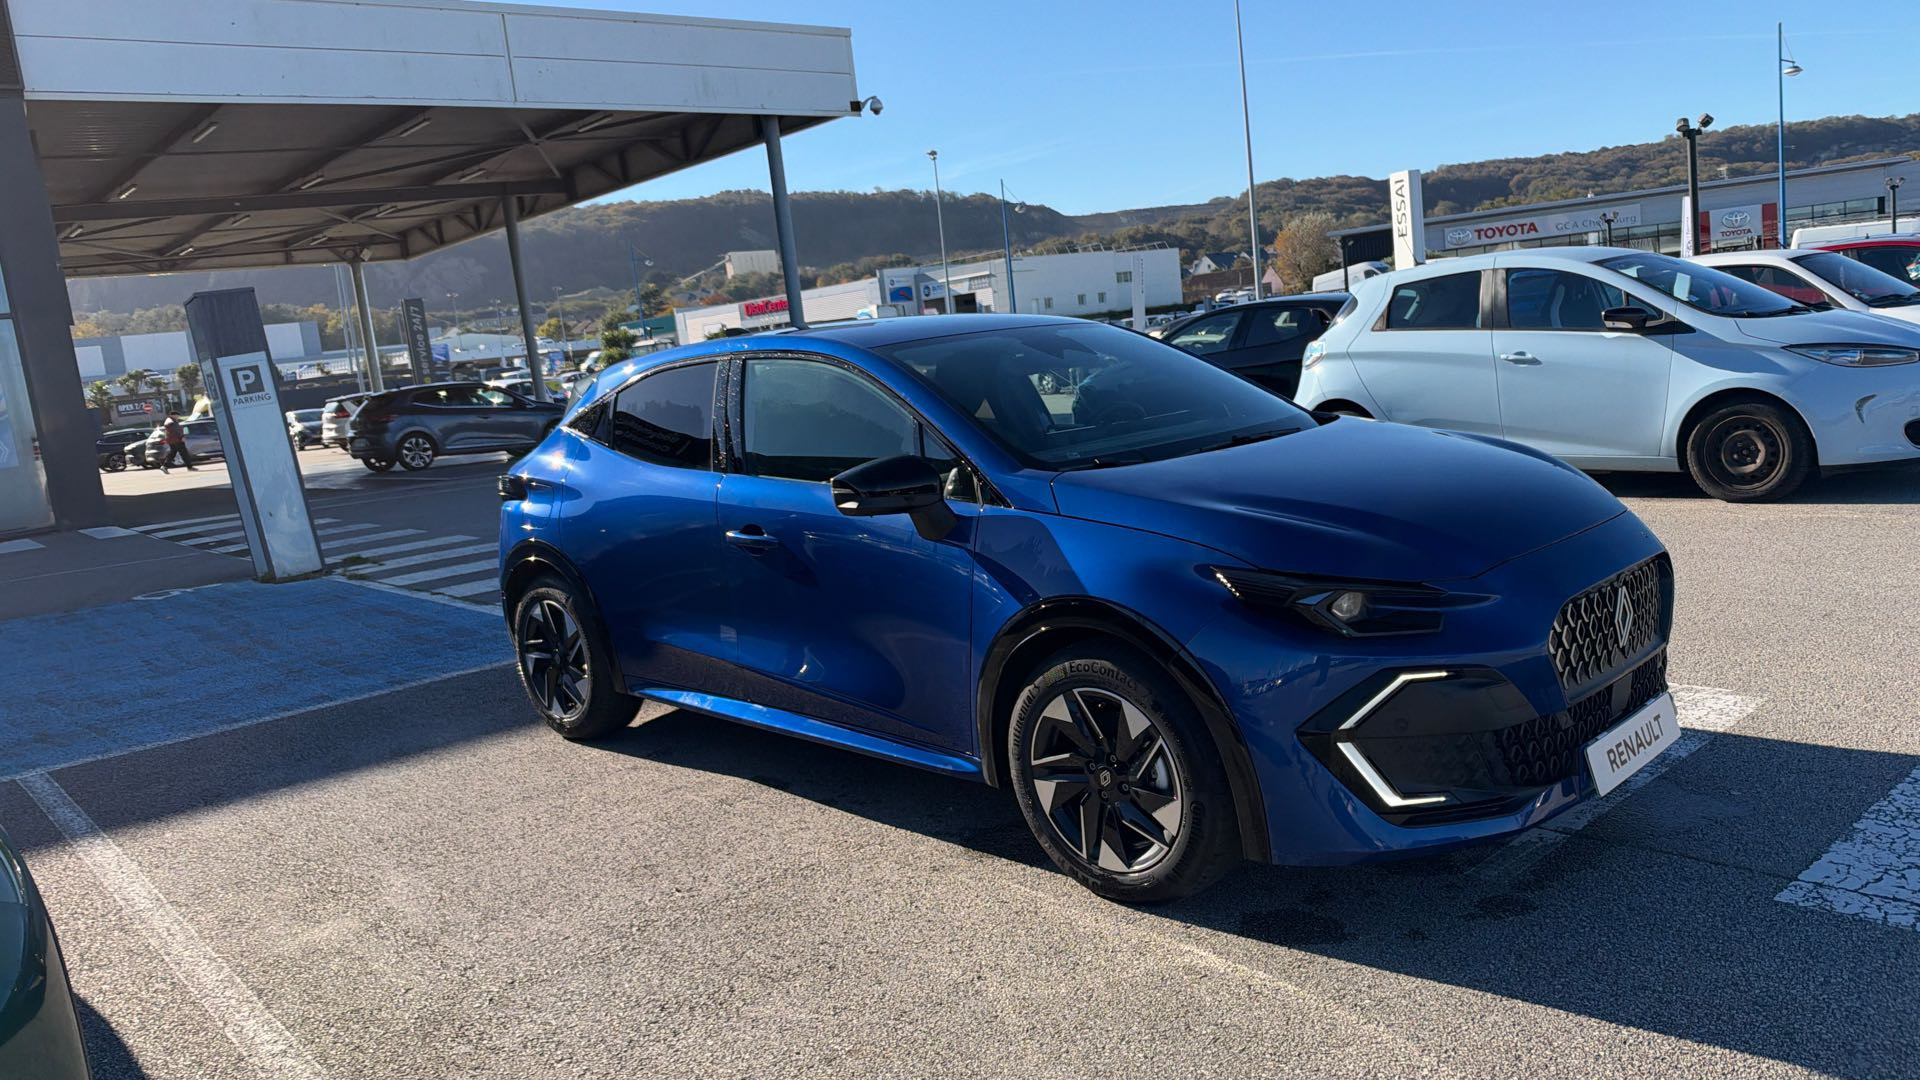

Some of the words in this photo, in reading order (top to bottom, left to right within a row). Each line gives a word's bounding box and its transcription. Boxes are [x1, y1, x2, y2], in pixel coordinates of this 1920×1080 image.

[1394, 179, 1408, 238] ESSAI
[1474, 221, 1539, 241] TOYOTA
[1555, 221, 1579, 232] GCA
[1720, 228, 1753, 238] TOYOTA
[410, 306, 423, 332] 24/7
[416, 334, 431, 375] service
[236, 369, 256, 393] P
[233, 393, 272, 406] PARKING
[1606, 713, 1664, 774] RENAULT
